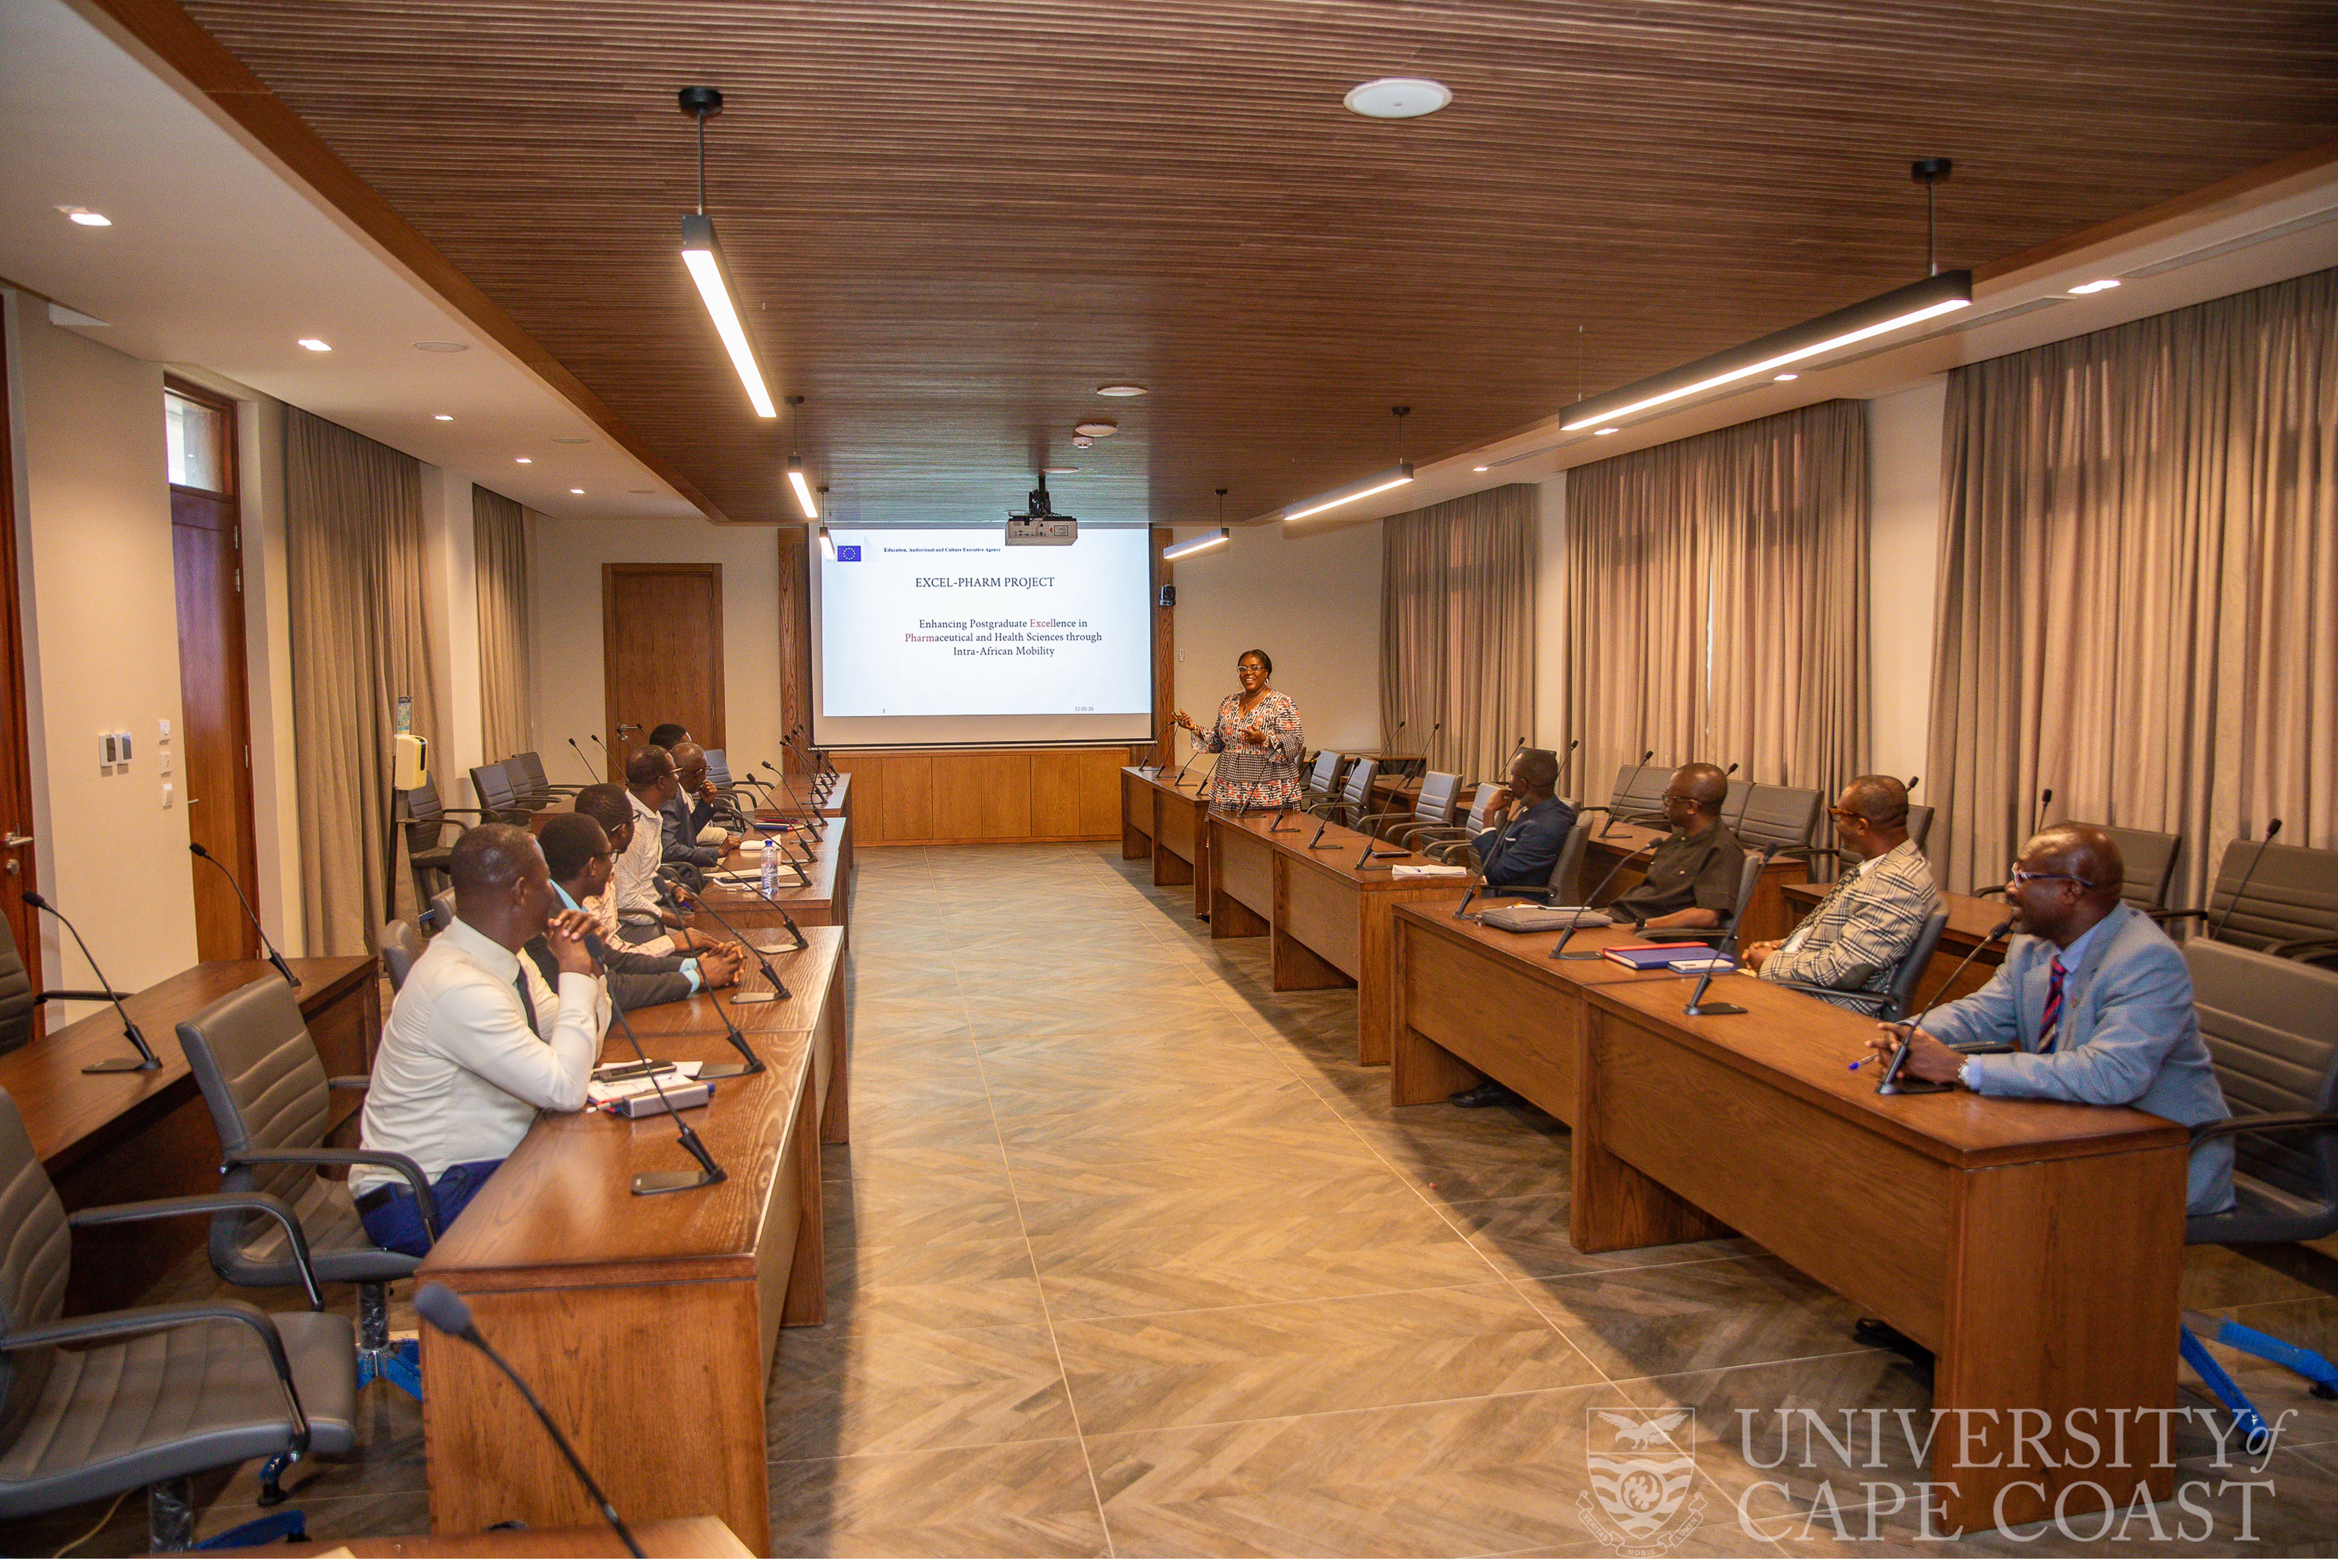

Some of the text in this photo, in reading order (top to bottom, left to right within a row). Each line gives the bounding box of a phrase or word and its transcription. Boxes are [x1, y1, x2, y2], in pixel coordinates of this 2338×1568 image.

[916, 577, 1055, 589] EXCEL-PHARM PROJECT
[919, 618, 1088, 630] Enhancing Postgraduate Excellence in
[905, 632, 1102, 643] Pharmaceutical and Health Sciences through
[953, 646, 1055, 657] Intra-African Mobility
